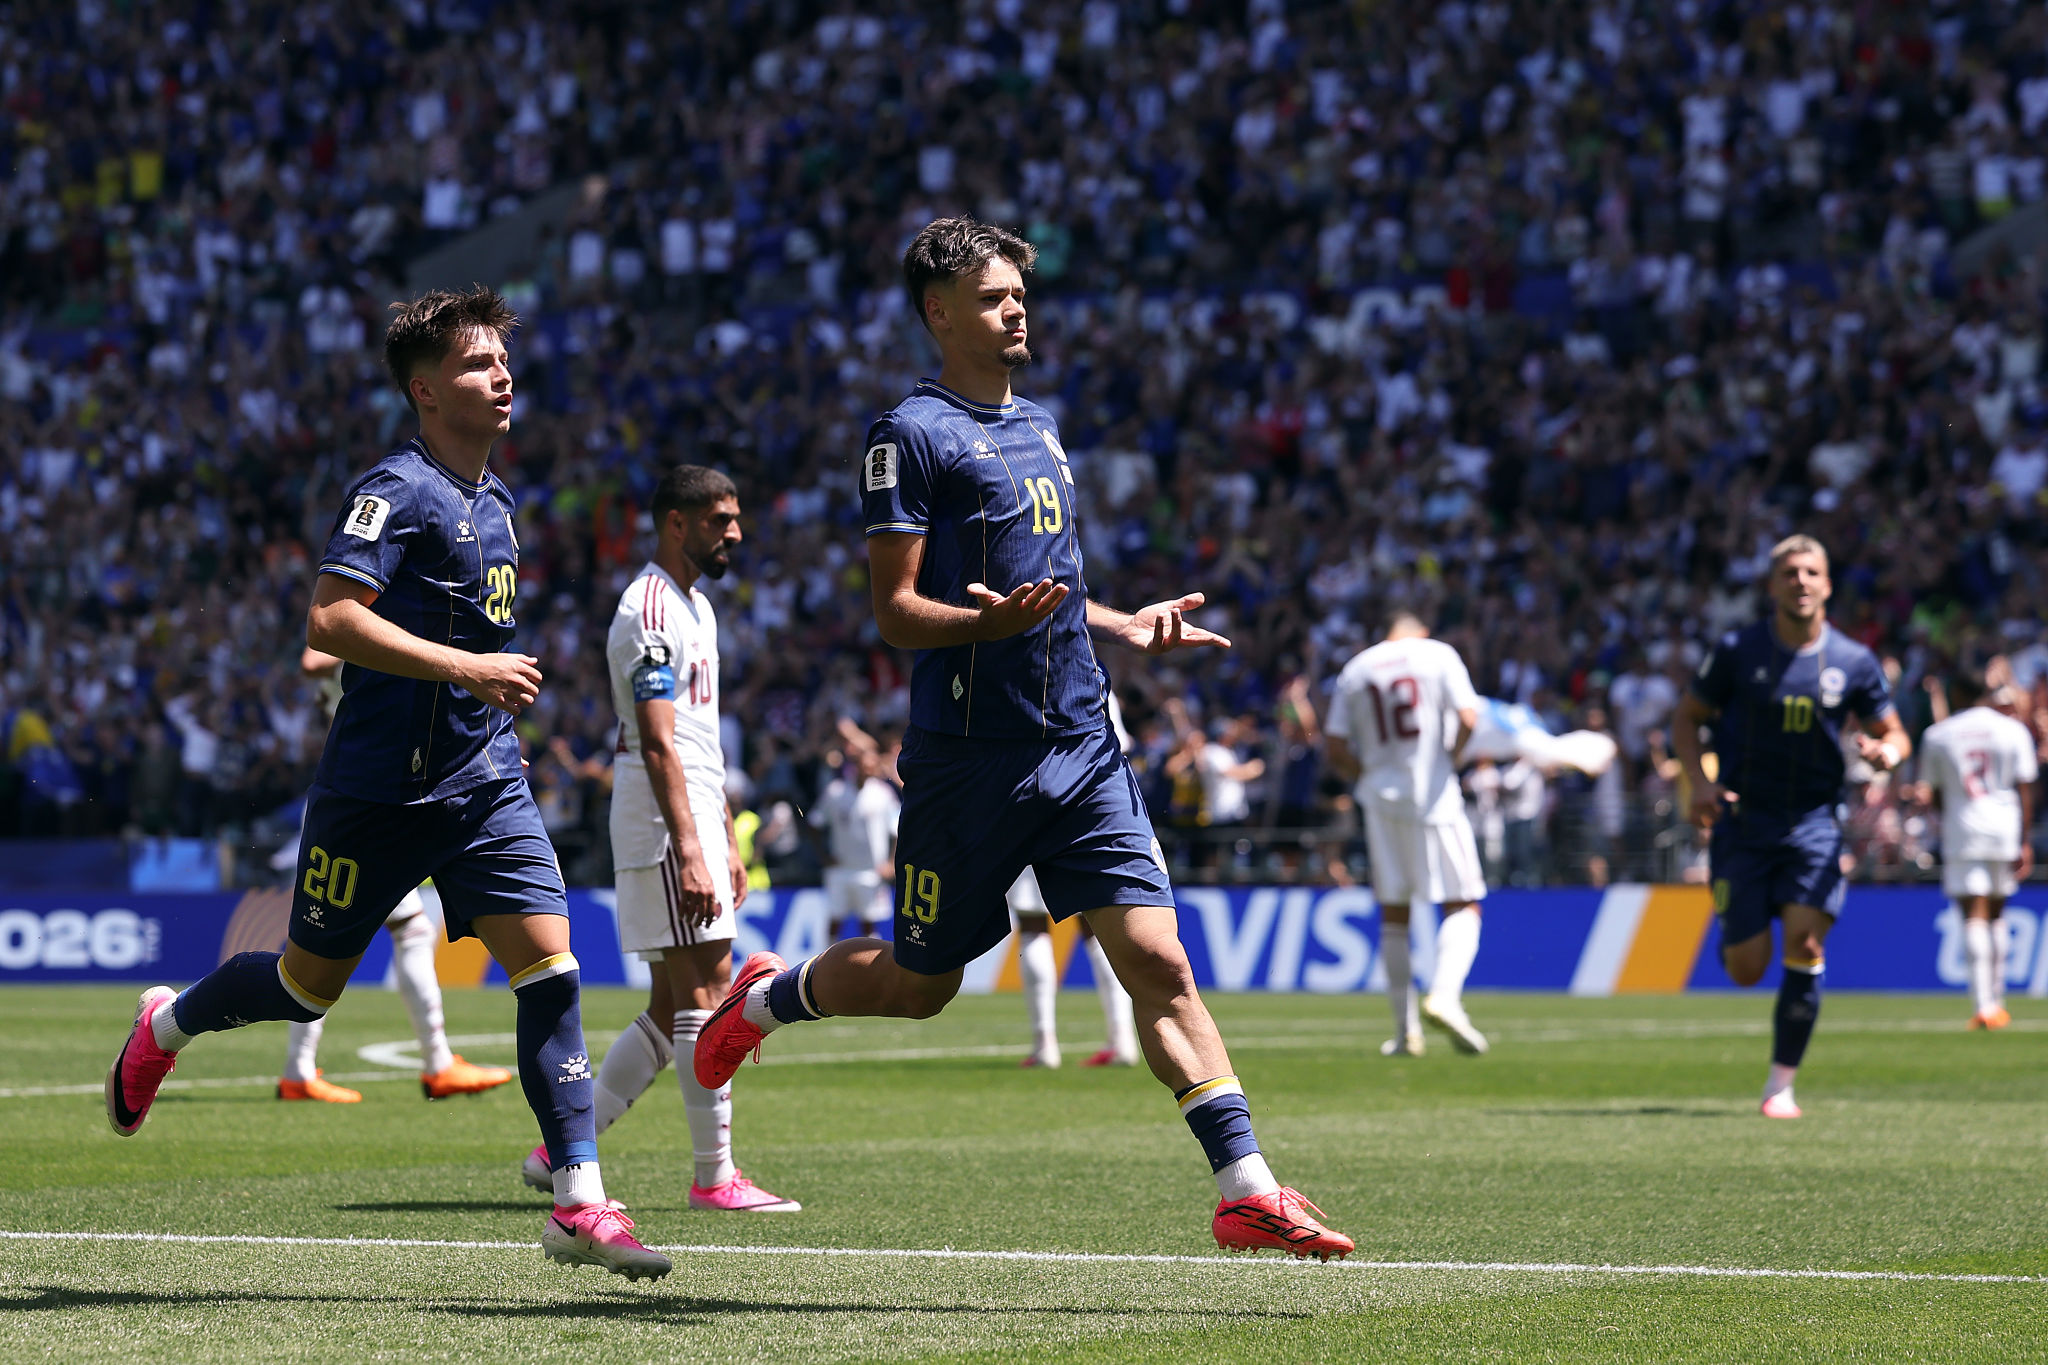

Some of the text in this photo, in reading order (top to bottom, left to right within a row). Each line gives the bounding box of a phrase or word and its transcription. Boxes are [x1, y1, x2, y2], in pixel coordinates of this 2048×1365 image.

[976, 452, 997, 460] KELME
[1024, 477, 1063, 534] 19
[485, 564, 517, 623] 20
[689, 658, 711, 705] 10
[1366, 676, 1421, 743] 12
[1781, 695, 1815, 734] 10
[303, 845, 360, 911] 20
[901, 863, 942, 926] 19
[0, 908, 143, 970] 026
[302, 914, 325, 929] KELME
[905, 936, 927, 947] KELME
[558, 1071, 592, 1084] KELME
[1218, 1205, 1321, 1244] F50
